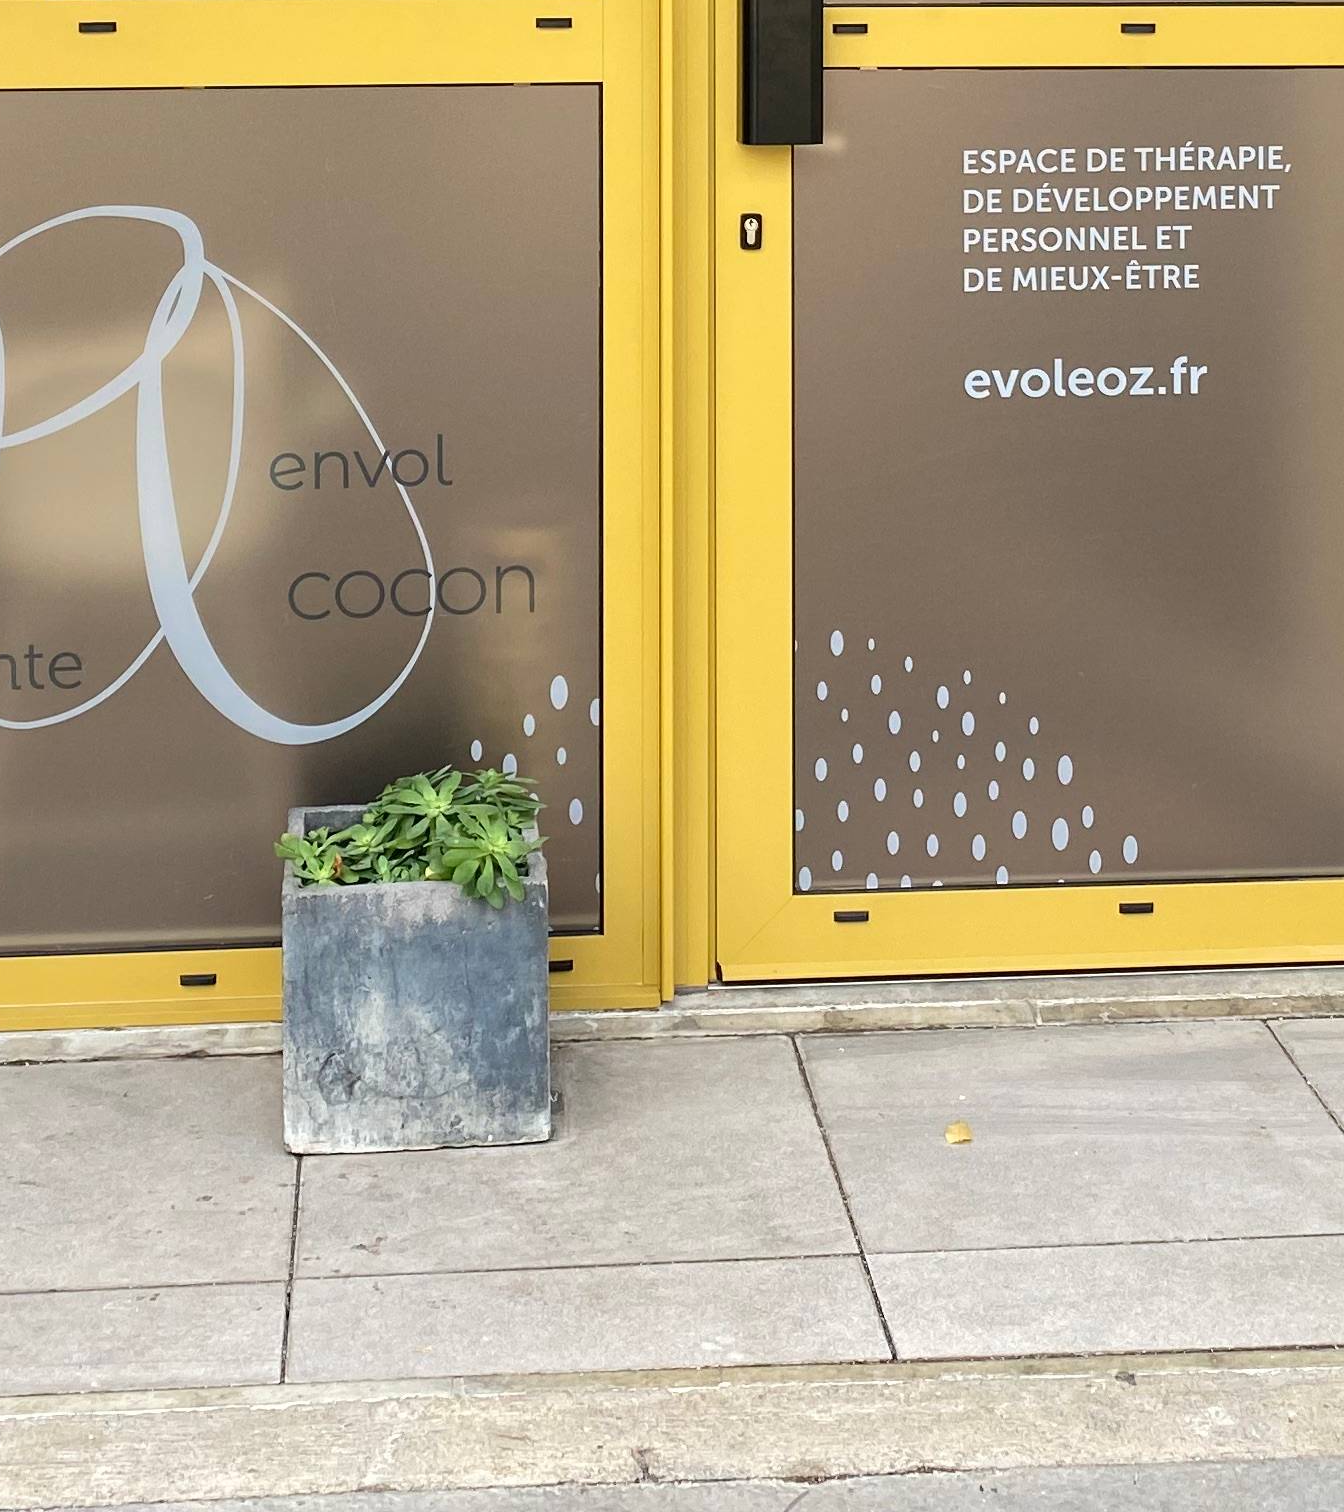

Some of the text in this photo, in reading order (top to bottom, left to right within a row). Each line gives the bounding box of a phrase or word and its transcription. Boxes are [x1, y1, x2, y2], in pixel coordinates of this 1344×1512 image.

[963, 141, 1291, 175] ESPACE DE THÉRAPIE,
[963, 183, 1280, 214] DE DÉVELOPPEMENT
[963, 225, 1192, 253] PERSONNEL ET
[963, 260, 1200, 293] DE MIEUX-ÊTRE
[964, 356, 1208, 399] evoleoz.fr
[269, 434, 453, 492] envol
[288, 560, 536, 620] cocon
